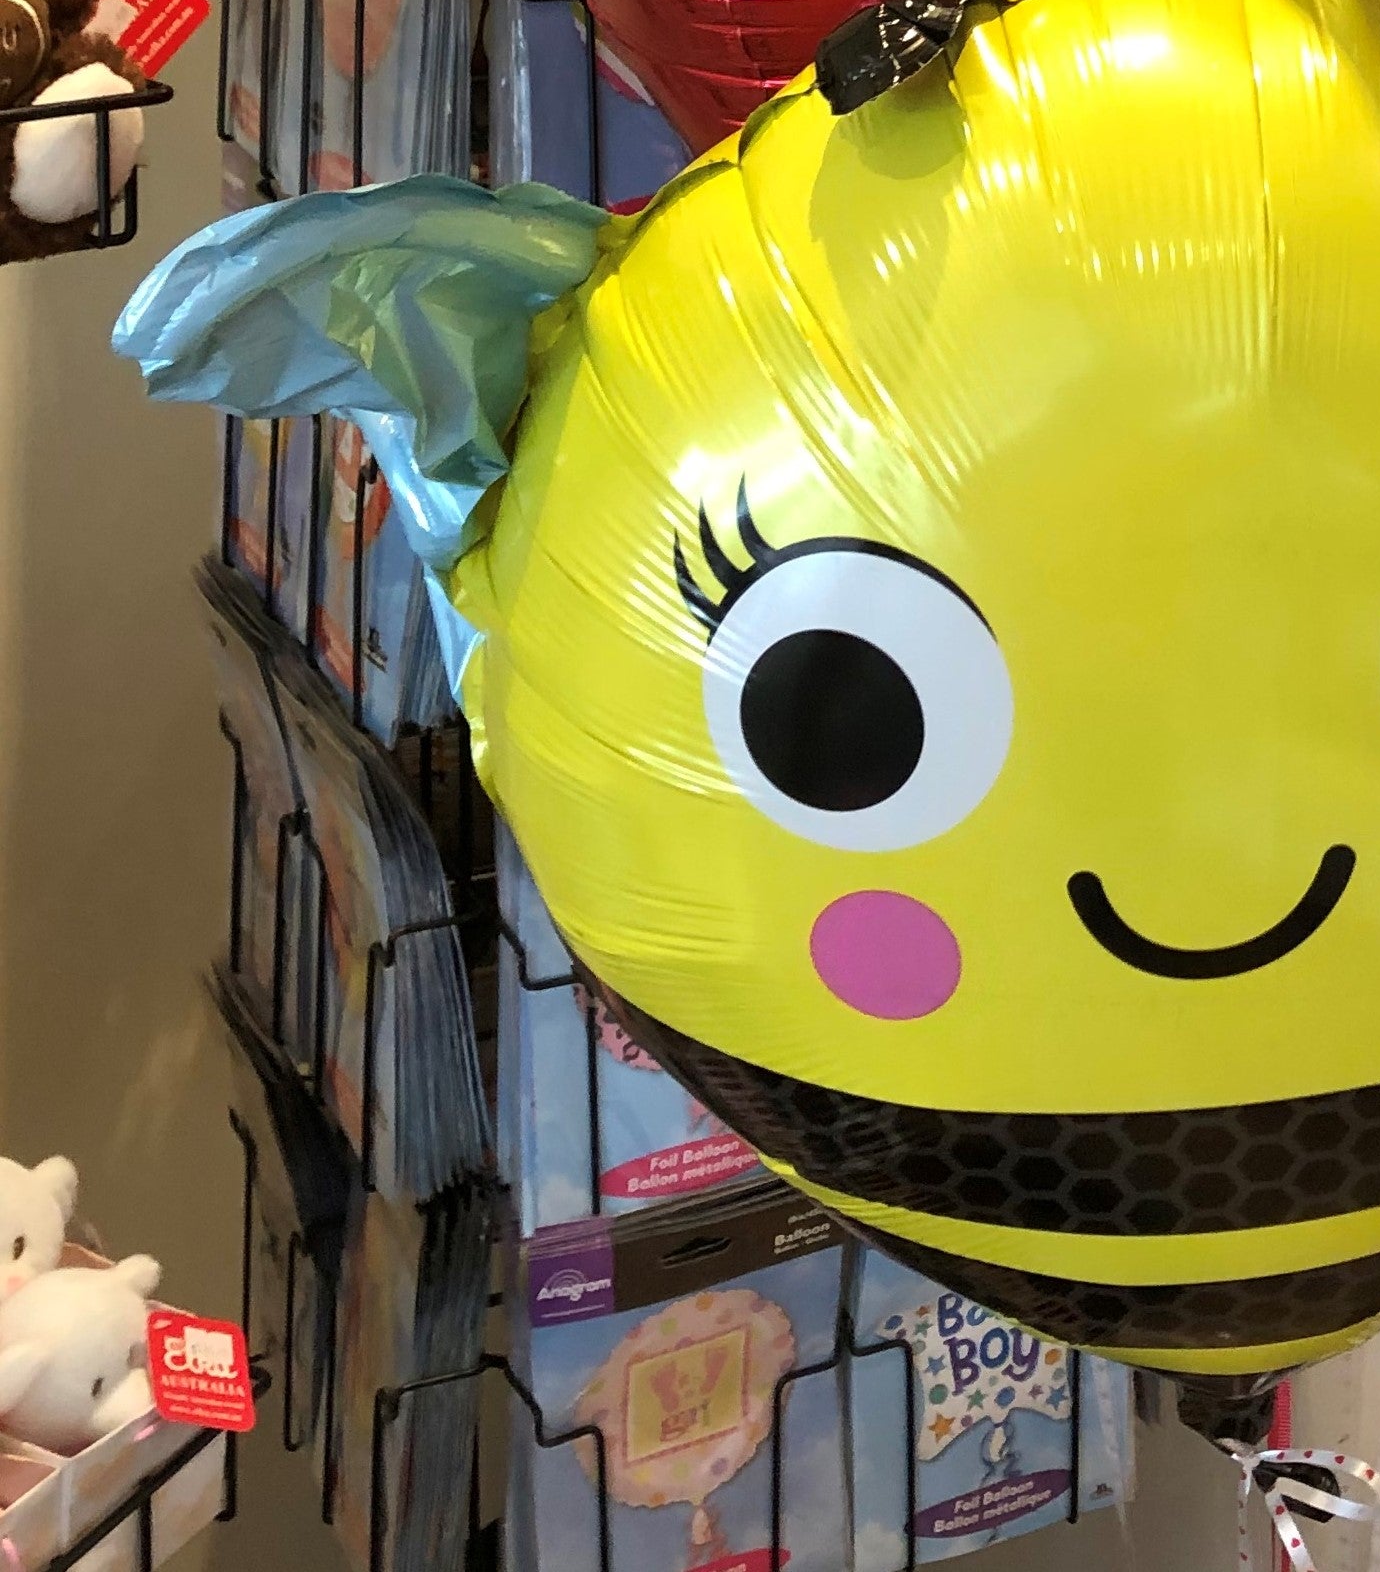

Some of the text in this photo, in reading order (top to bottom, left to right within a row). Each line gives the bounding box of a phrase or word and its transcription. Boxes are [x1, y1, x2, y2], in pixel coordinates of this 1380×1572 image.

[650, 1139, 741, 1173] Foil Balloon
[536, 1277, 613, 1303] Anagram
